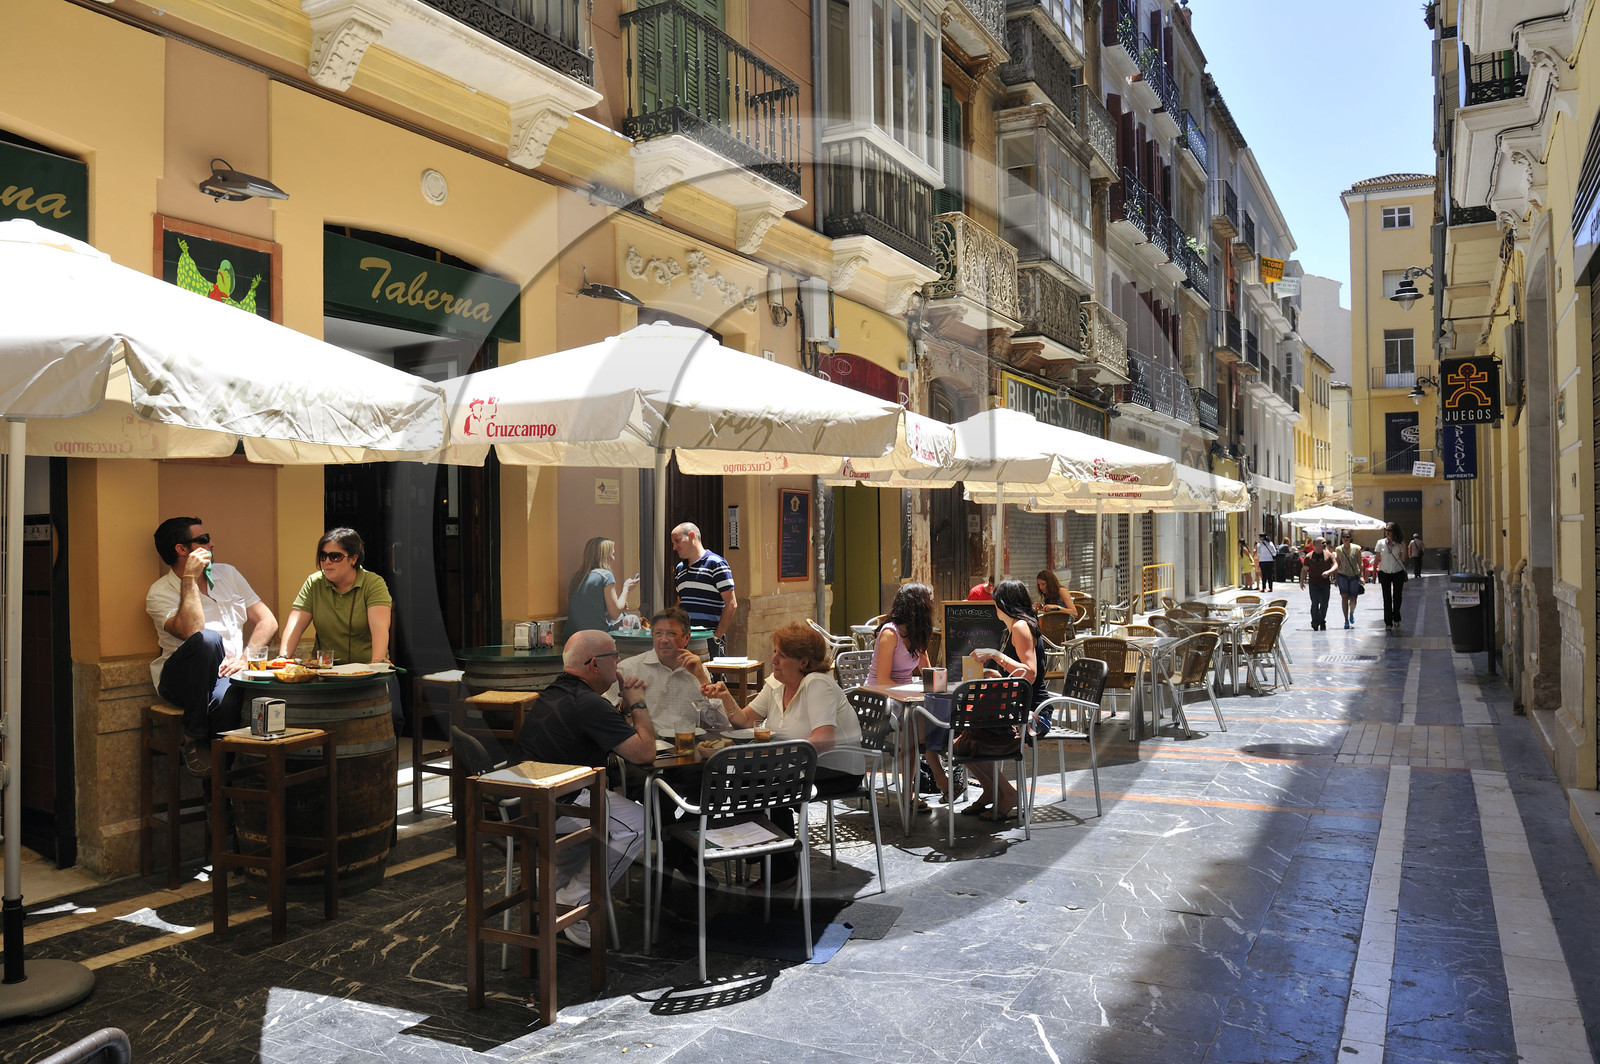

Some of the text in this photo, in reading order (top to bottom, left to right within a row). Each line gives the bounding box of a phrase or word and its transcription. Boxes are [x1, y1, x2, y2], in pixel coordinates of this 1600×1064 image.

[0, 185, 72, 219] na
[359, 256, 493, 323] Taberna
[1008, 380, 1064, 426] BILLARES
[1445, 408, 1491, 421] JUEGOS
[486, 421, 557, 439] Cruzcampo
[1454, 425, 1465, 472] SPAÑOLA
